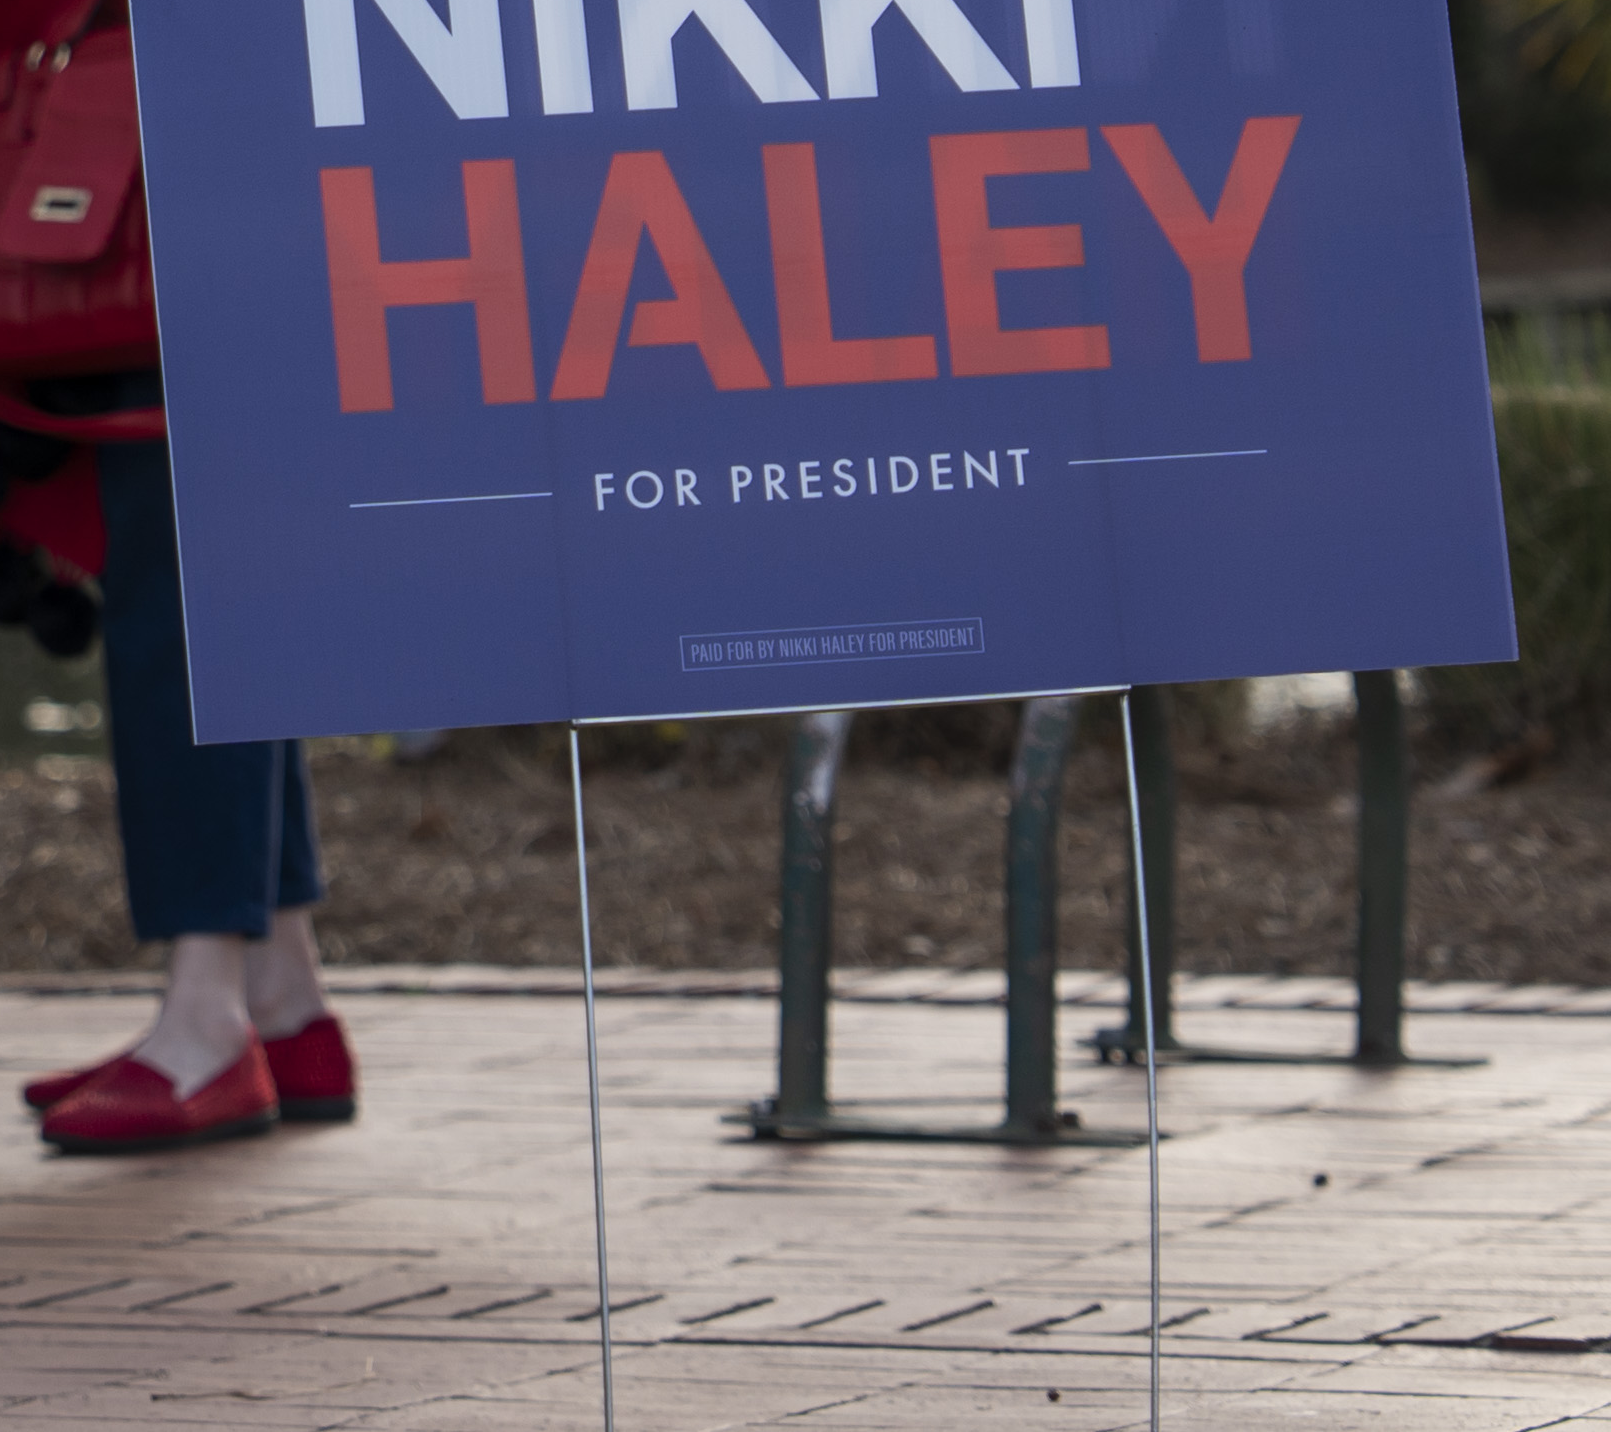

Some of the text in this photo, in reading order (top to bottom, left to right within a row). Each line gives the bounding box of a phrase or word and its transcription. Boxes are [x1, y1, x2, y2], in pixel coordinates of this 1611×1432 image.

[320, 114, 1302, 413] HALEY
[593, 448, 1031, 513] FOR PRESIDENT
[691, 627, 975, 663] PAID FOR BY NIKKI HALEY FOR PRESIDENT
